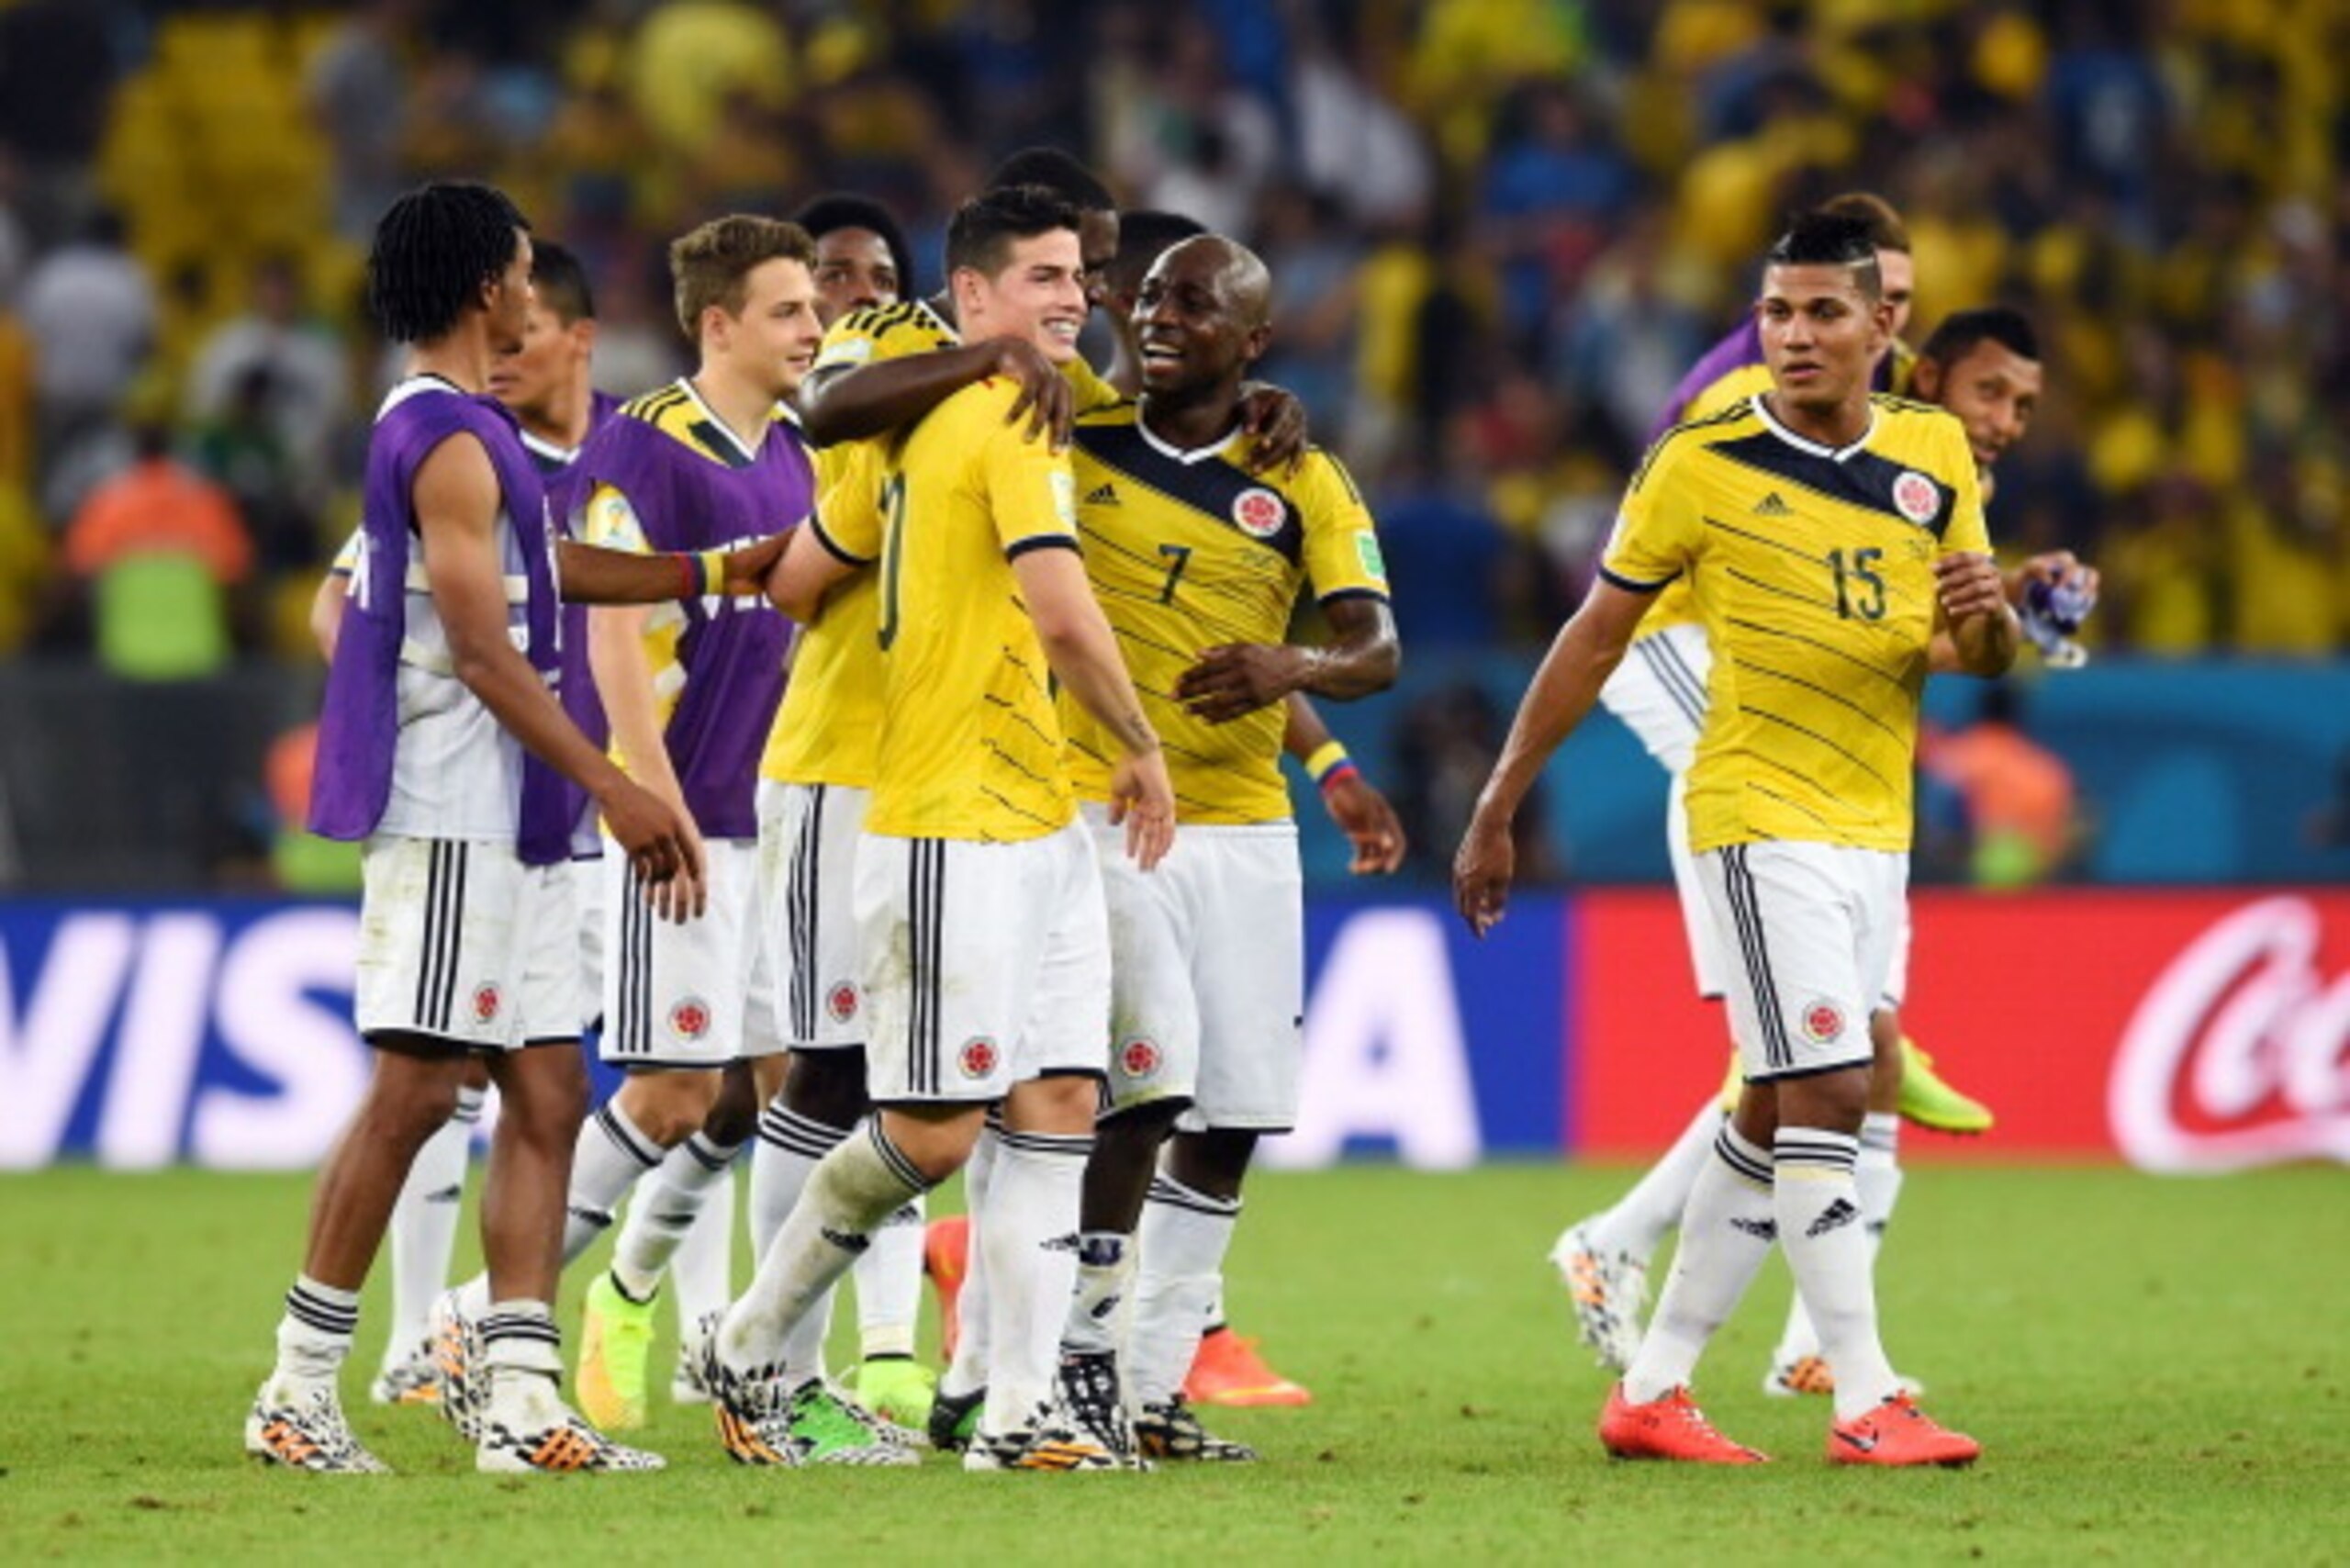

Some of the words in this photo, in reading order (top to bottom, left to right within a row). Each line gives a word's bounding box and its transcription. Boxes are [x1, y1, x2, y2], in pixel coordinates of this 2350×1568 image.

[1158, 543, 1192, 603] 7
[1827, 548, 1886, 621] 15
[0, 907, 500, 1170] VIS
